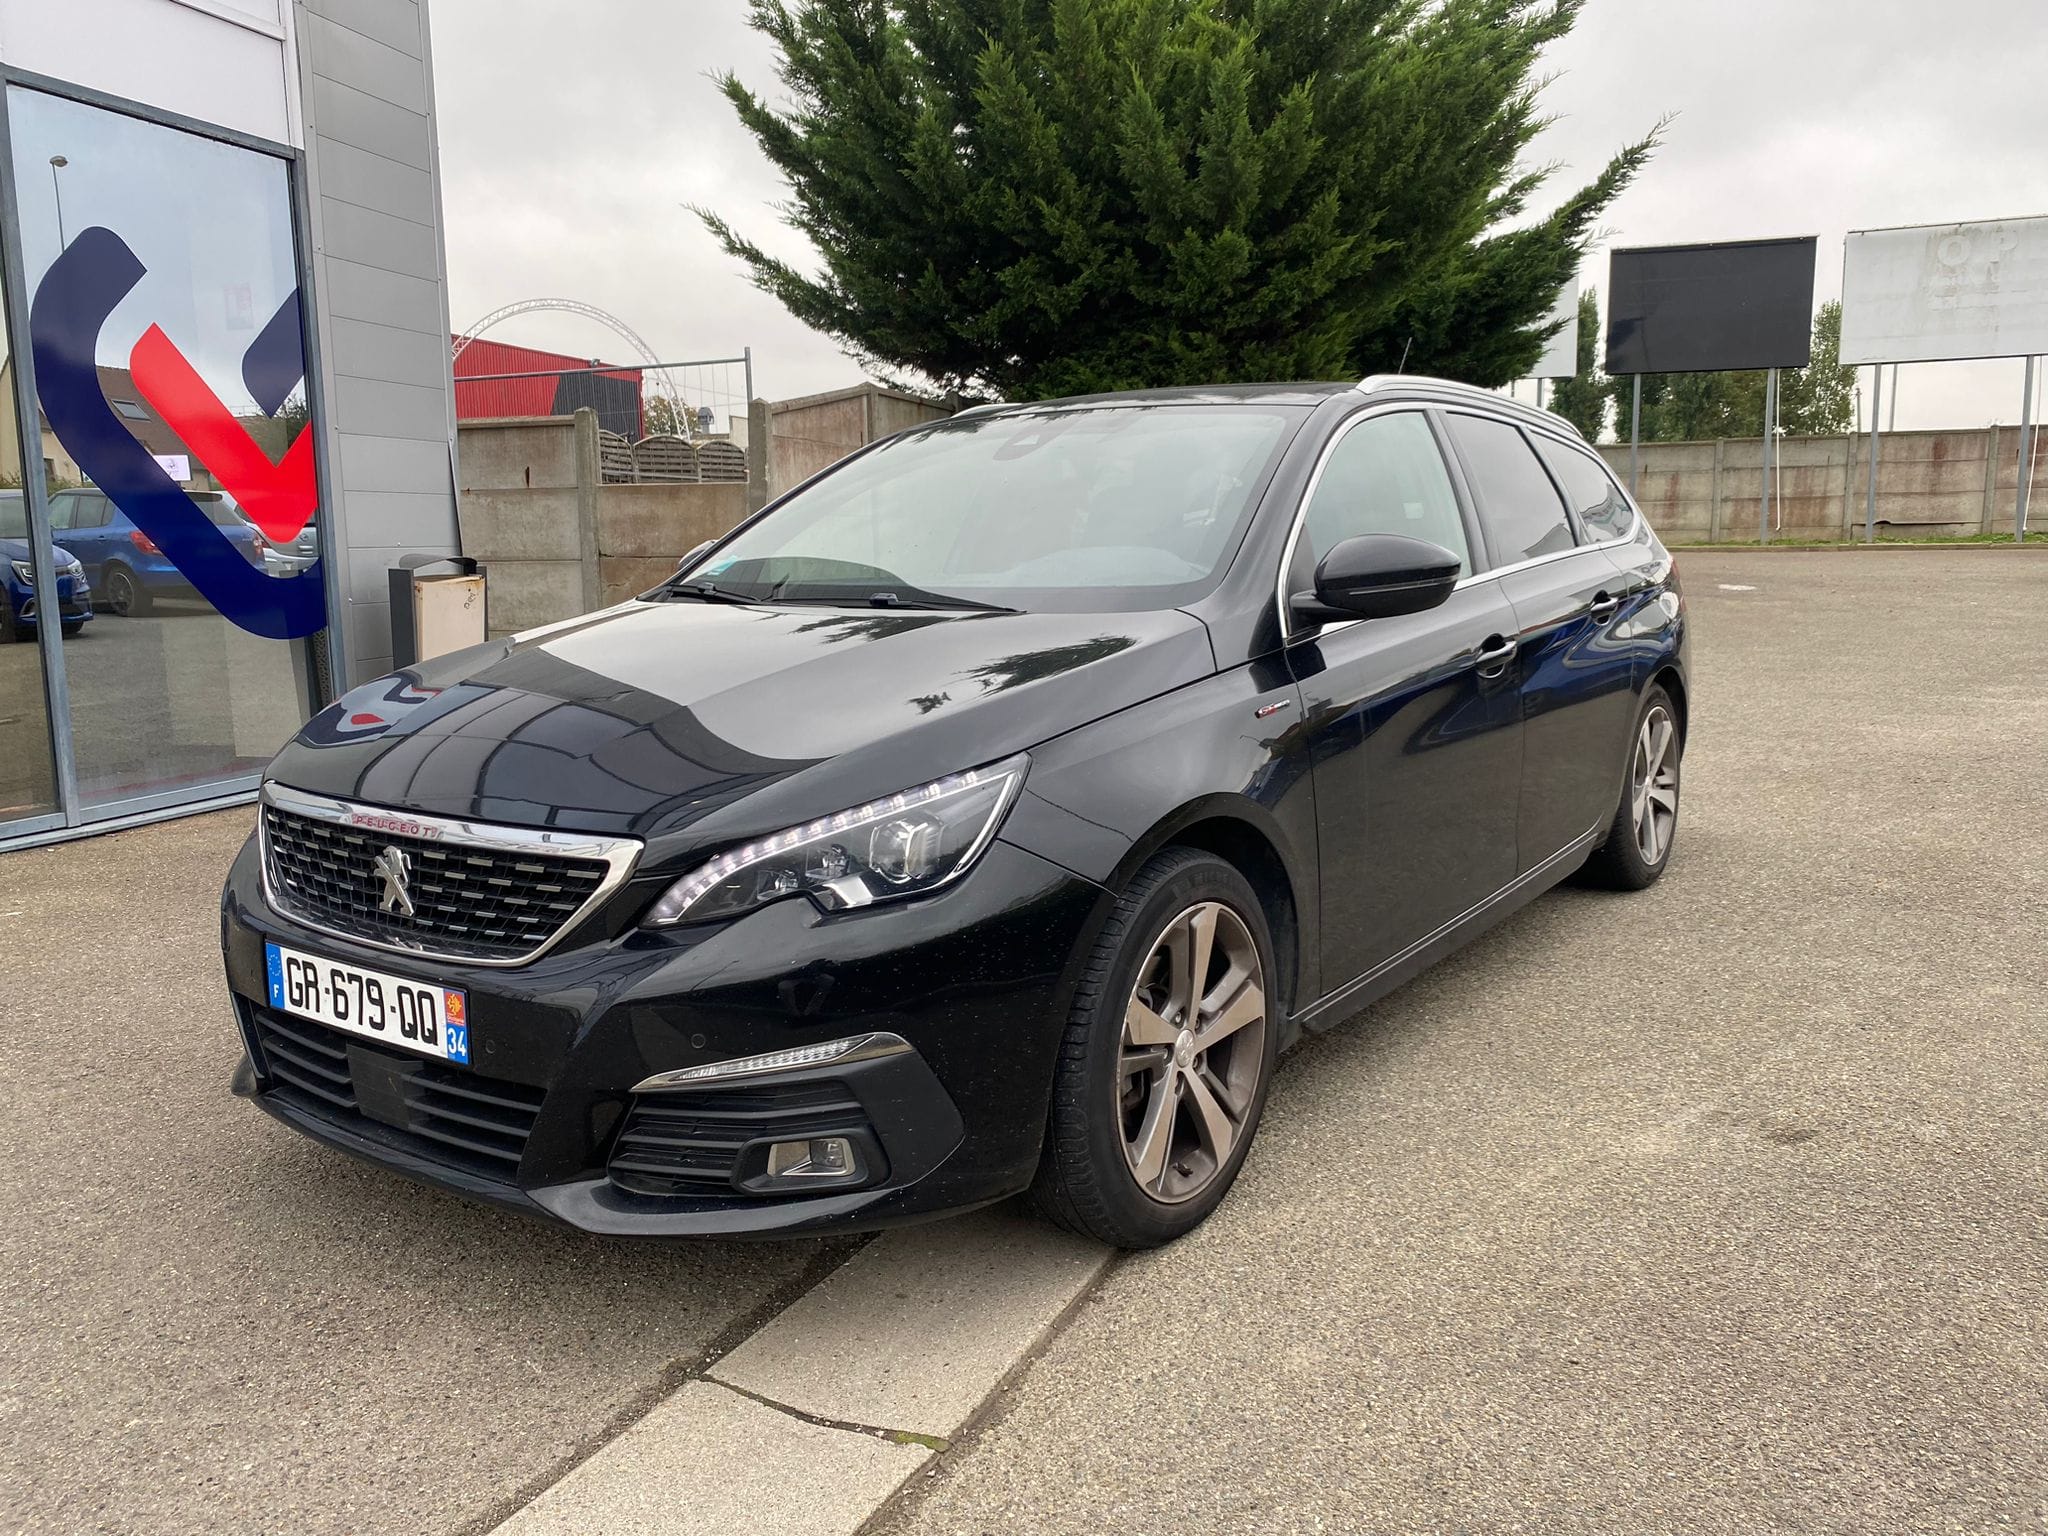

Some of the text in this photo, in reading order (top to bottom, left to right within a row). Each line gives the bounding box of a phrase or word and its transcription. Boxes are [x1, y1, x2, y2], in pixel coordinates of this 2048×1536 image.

[355, 815, 431, 837] PEUGEOT
[273, 984, 279, 998] F
[286, 957, 438, 1046] GR-679-QQ
[447, 1027, 467, 1056] 34
